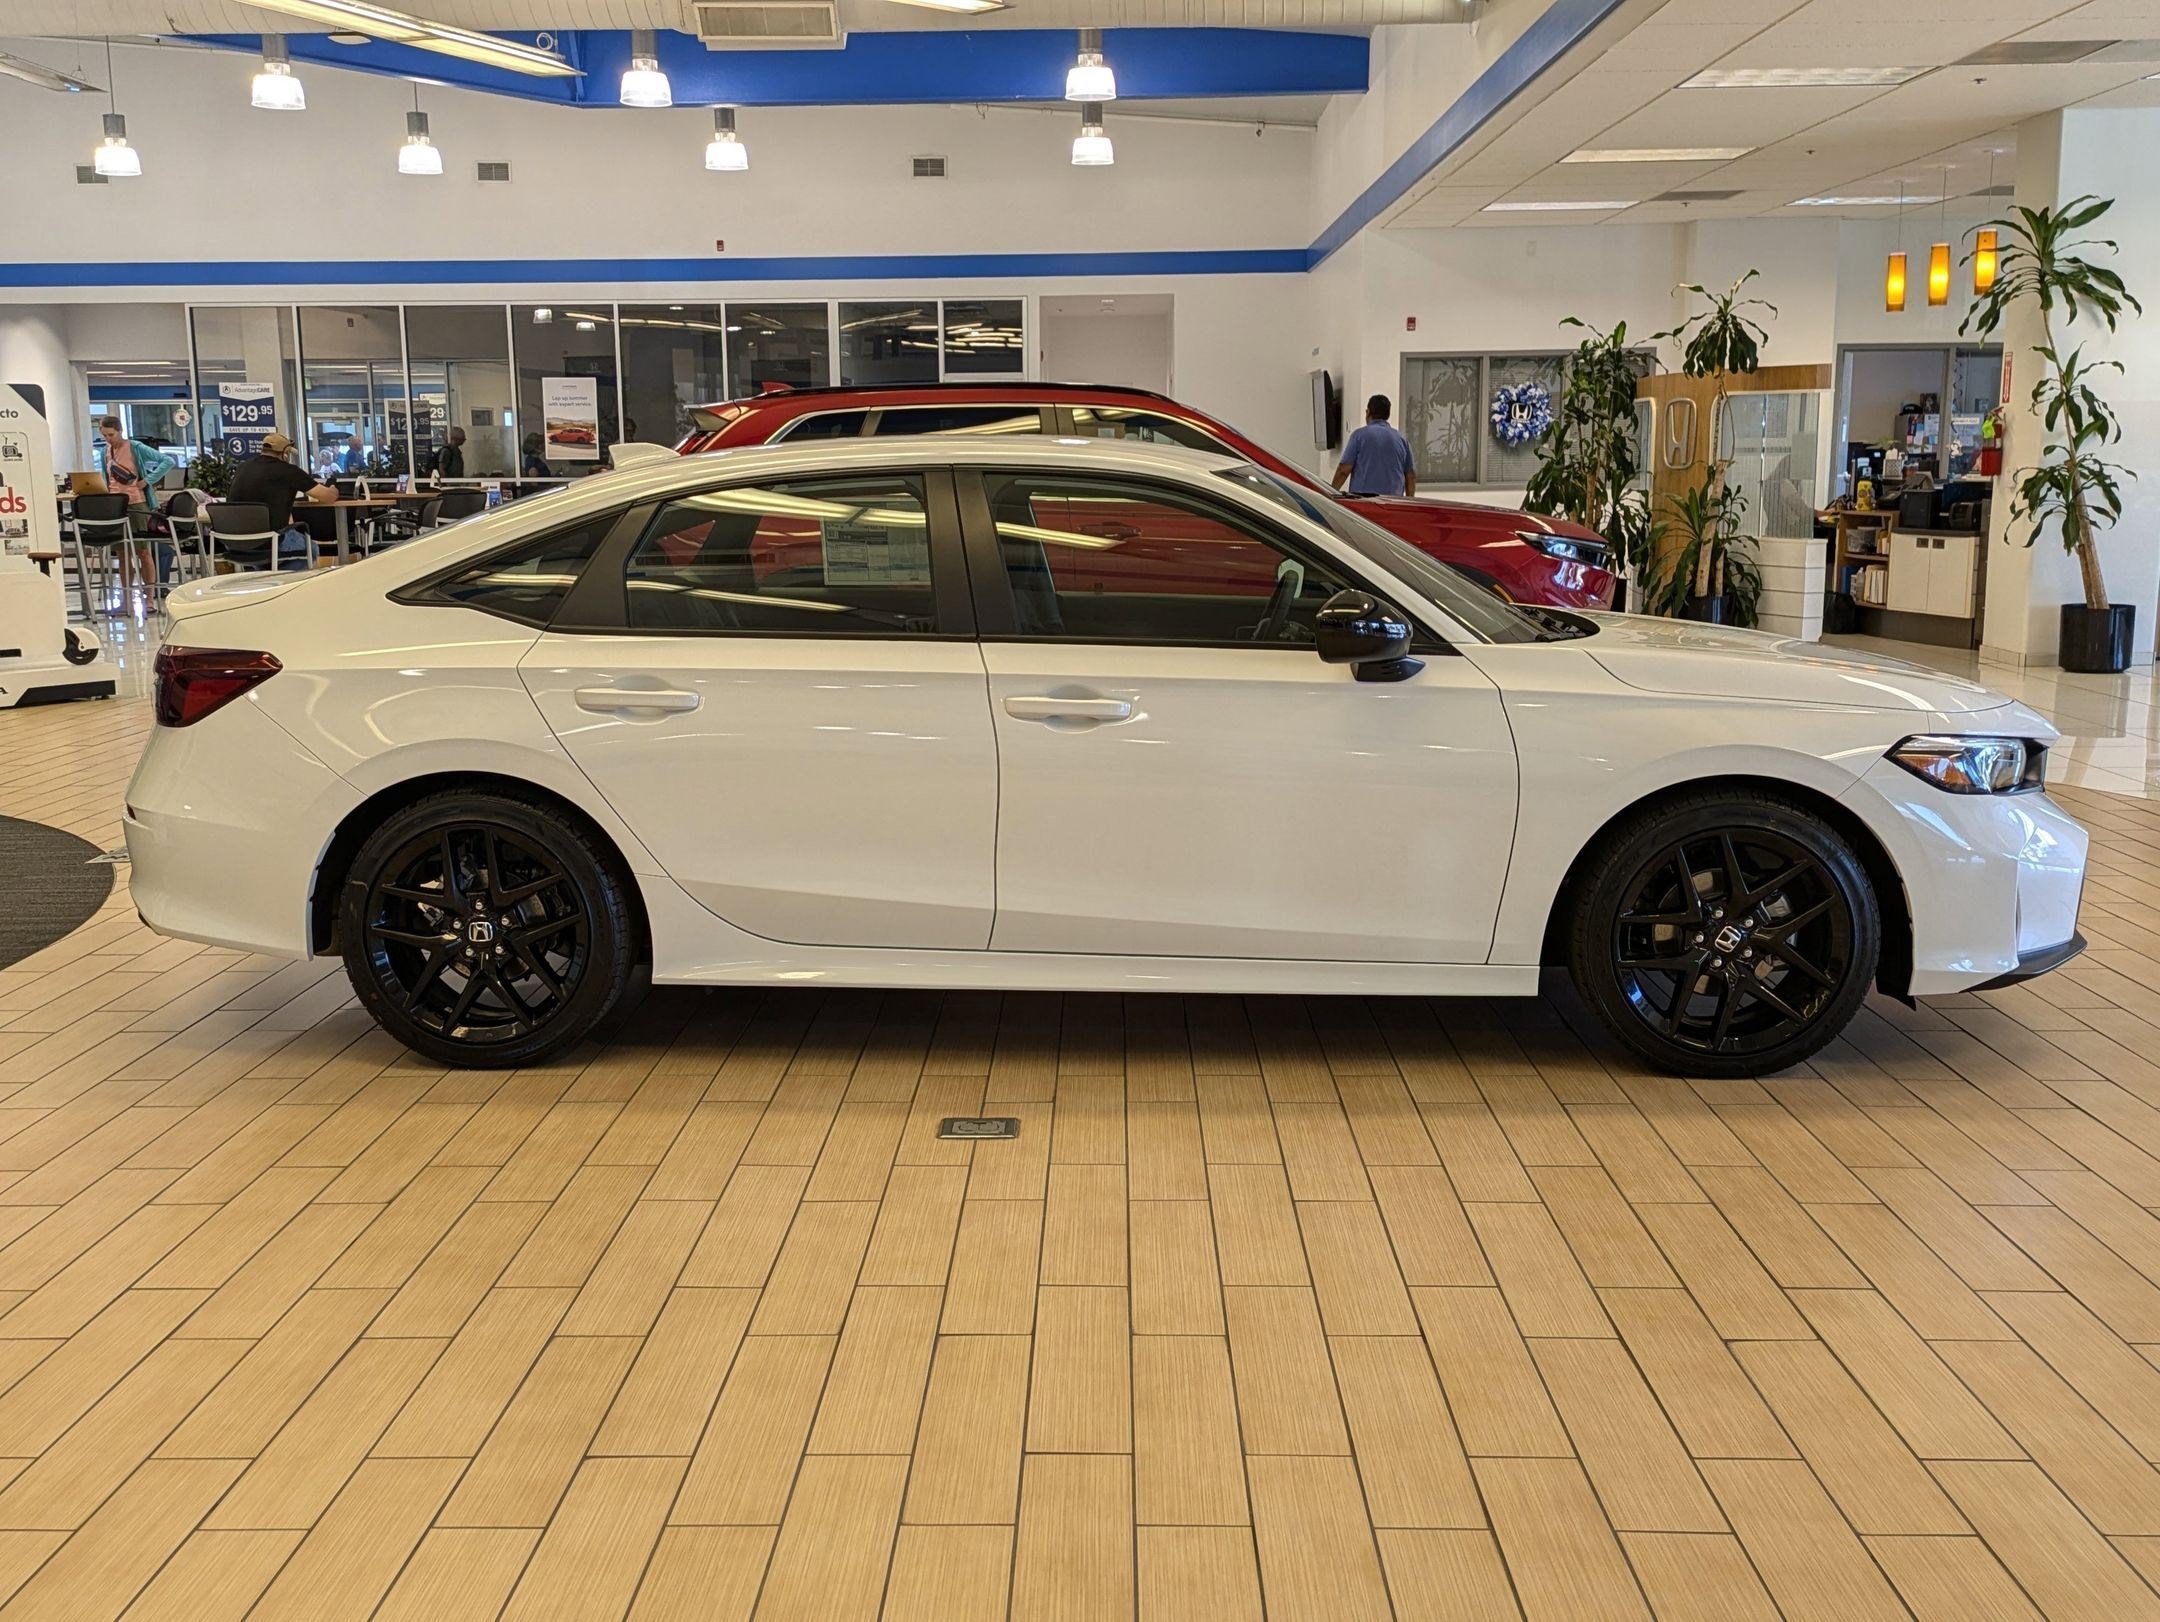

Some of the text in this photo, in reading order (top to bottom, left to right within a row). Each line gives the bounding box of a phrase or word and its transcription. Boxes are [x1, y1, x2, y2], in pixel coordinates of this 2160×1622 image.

[222, 405, 273, 422] $129.95
[232, 440, 242, 453] 3
[0, 486, 27, 514] ds
